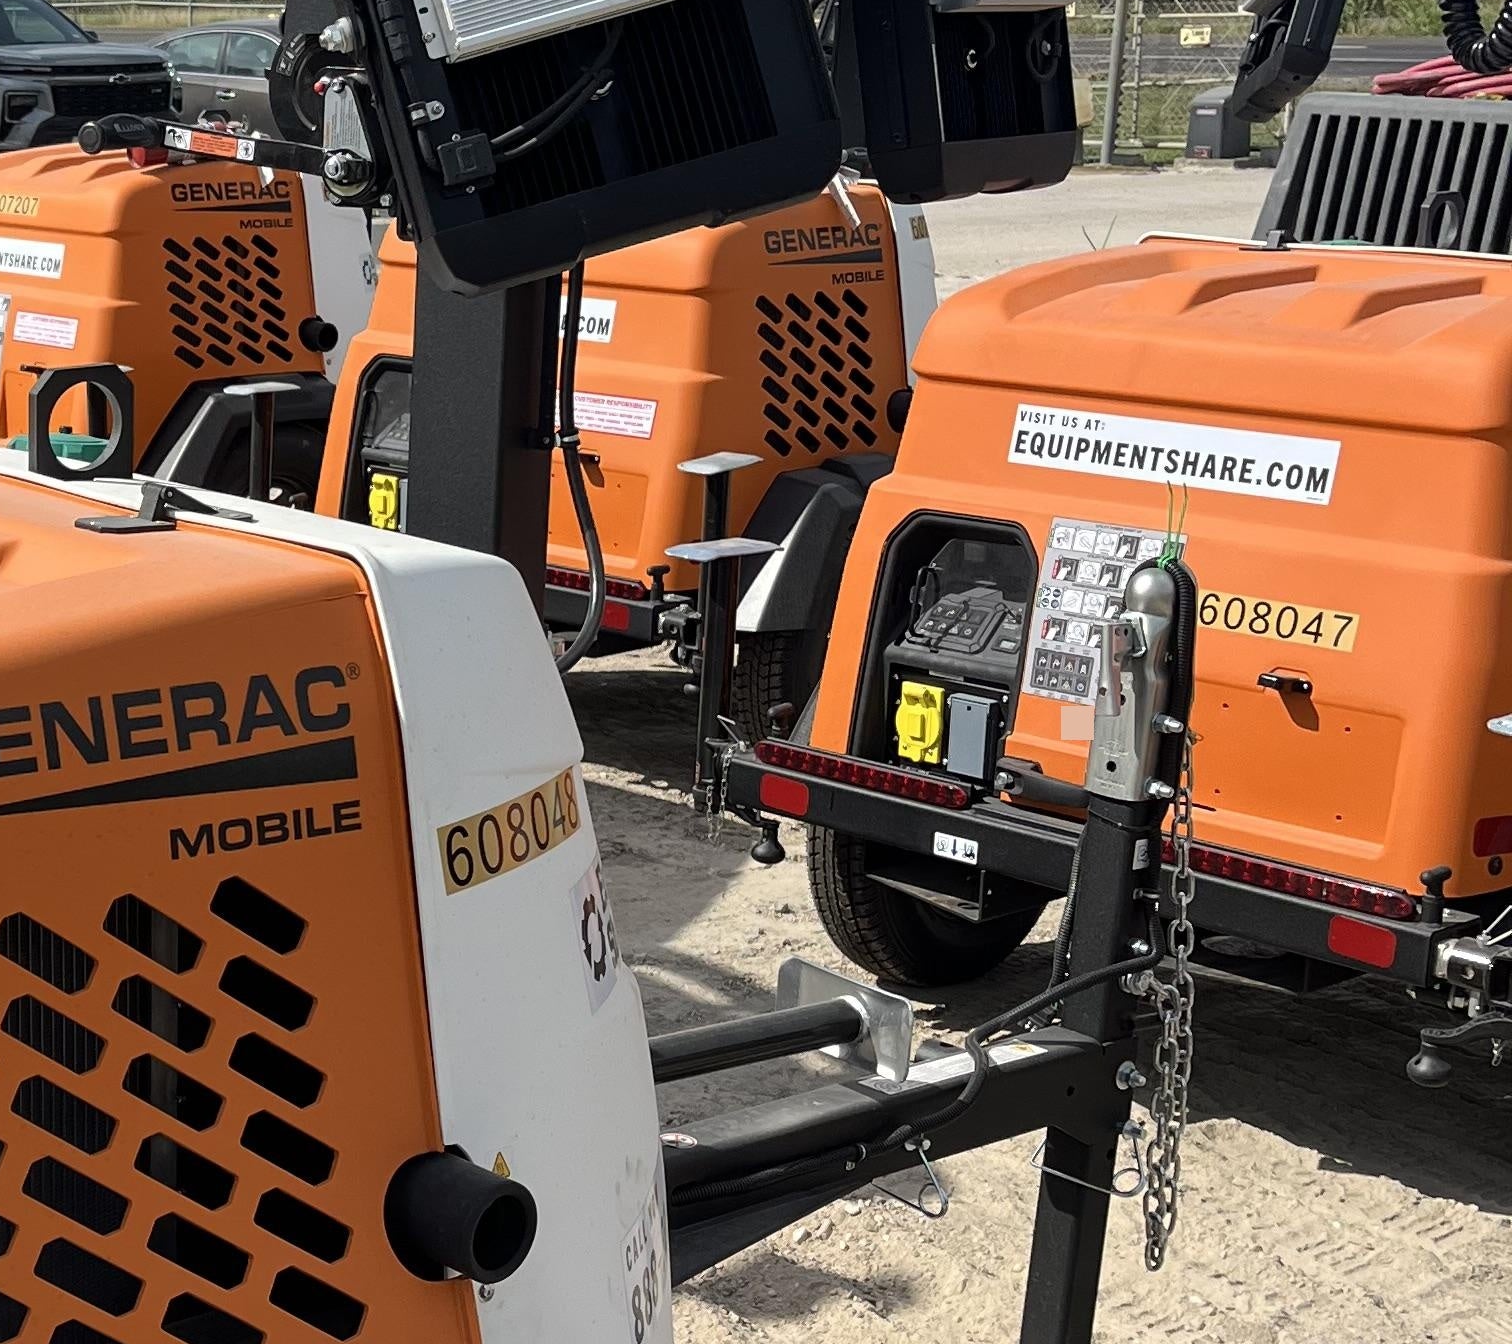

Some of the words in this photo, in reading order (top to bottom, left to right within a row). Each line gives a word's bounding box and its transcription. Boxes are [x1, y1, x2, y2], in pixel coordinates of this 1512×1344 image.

[240, 218, 293, 229] MOBILE
[764, 224, 881, 255] GENERAC
[832, 269, 885, 285] MOBILE
[1020, 410, 1055, 425] VISIT
[1061, 416, 1079, 428] US
[1084, 419, 1106, 431] AT:
[1015, 430, 1330, 494] EQUIPMENTSHARE.COM
[1199, 592, 1354, 648] 608047
[169, 800, 363, 860] MOBILE
[445, 772, 580, 887] 608048
